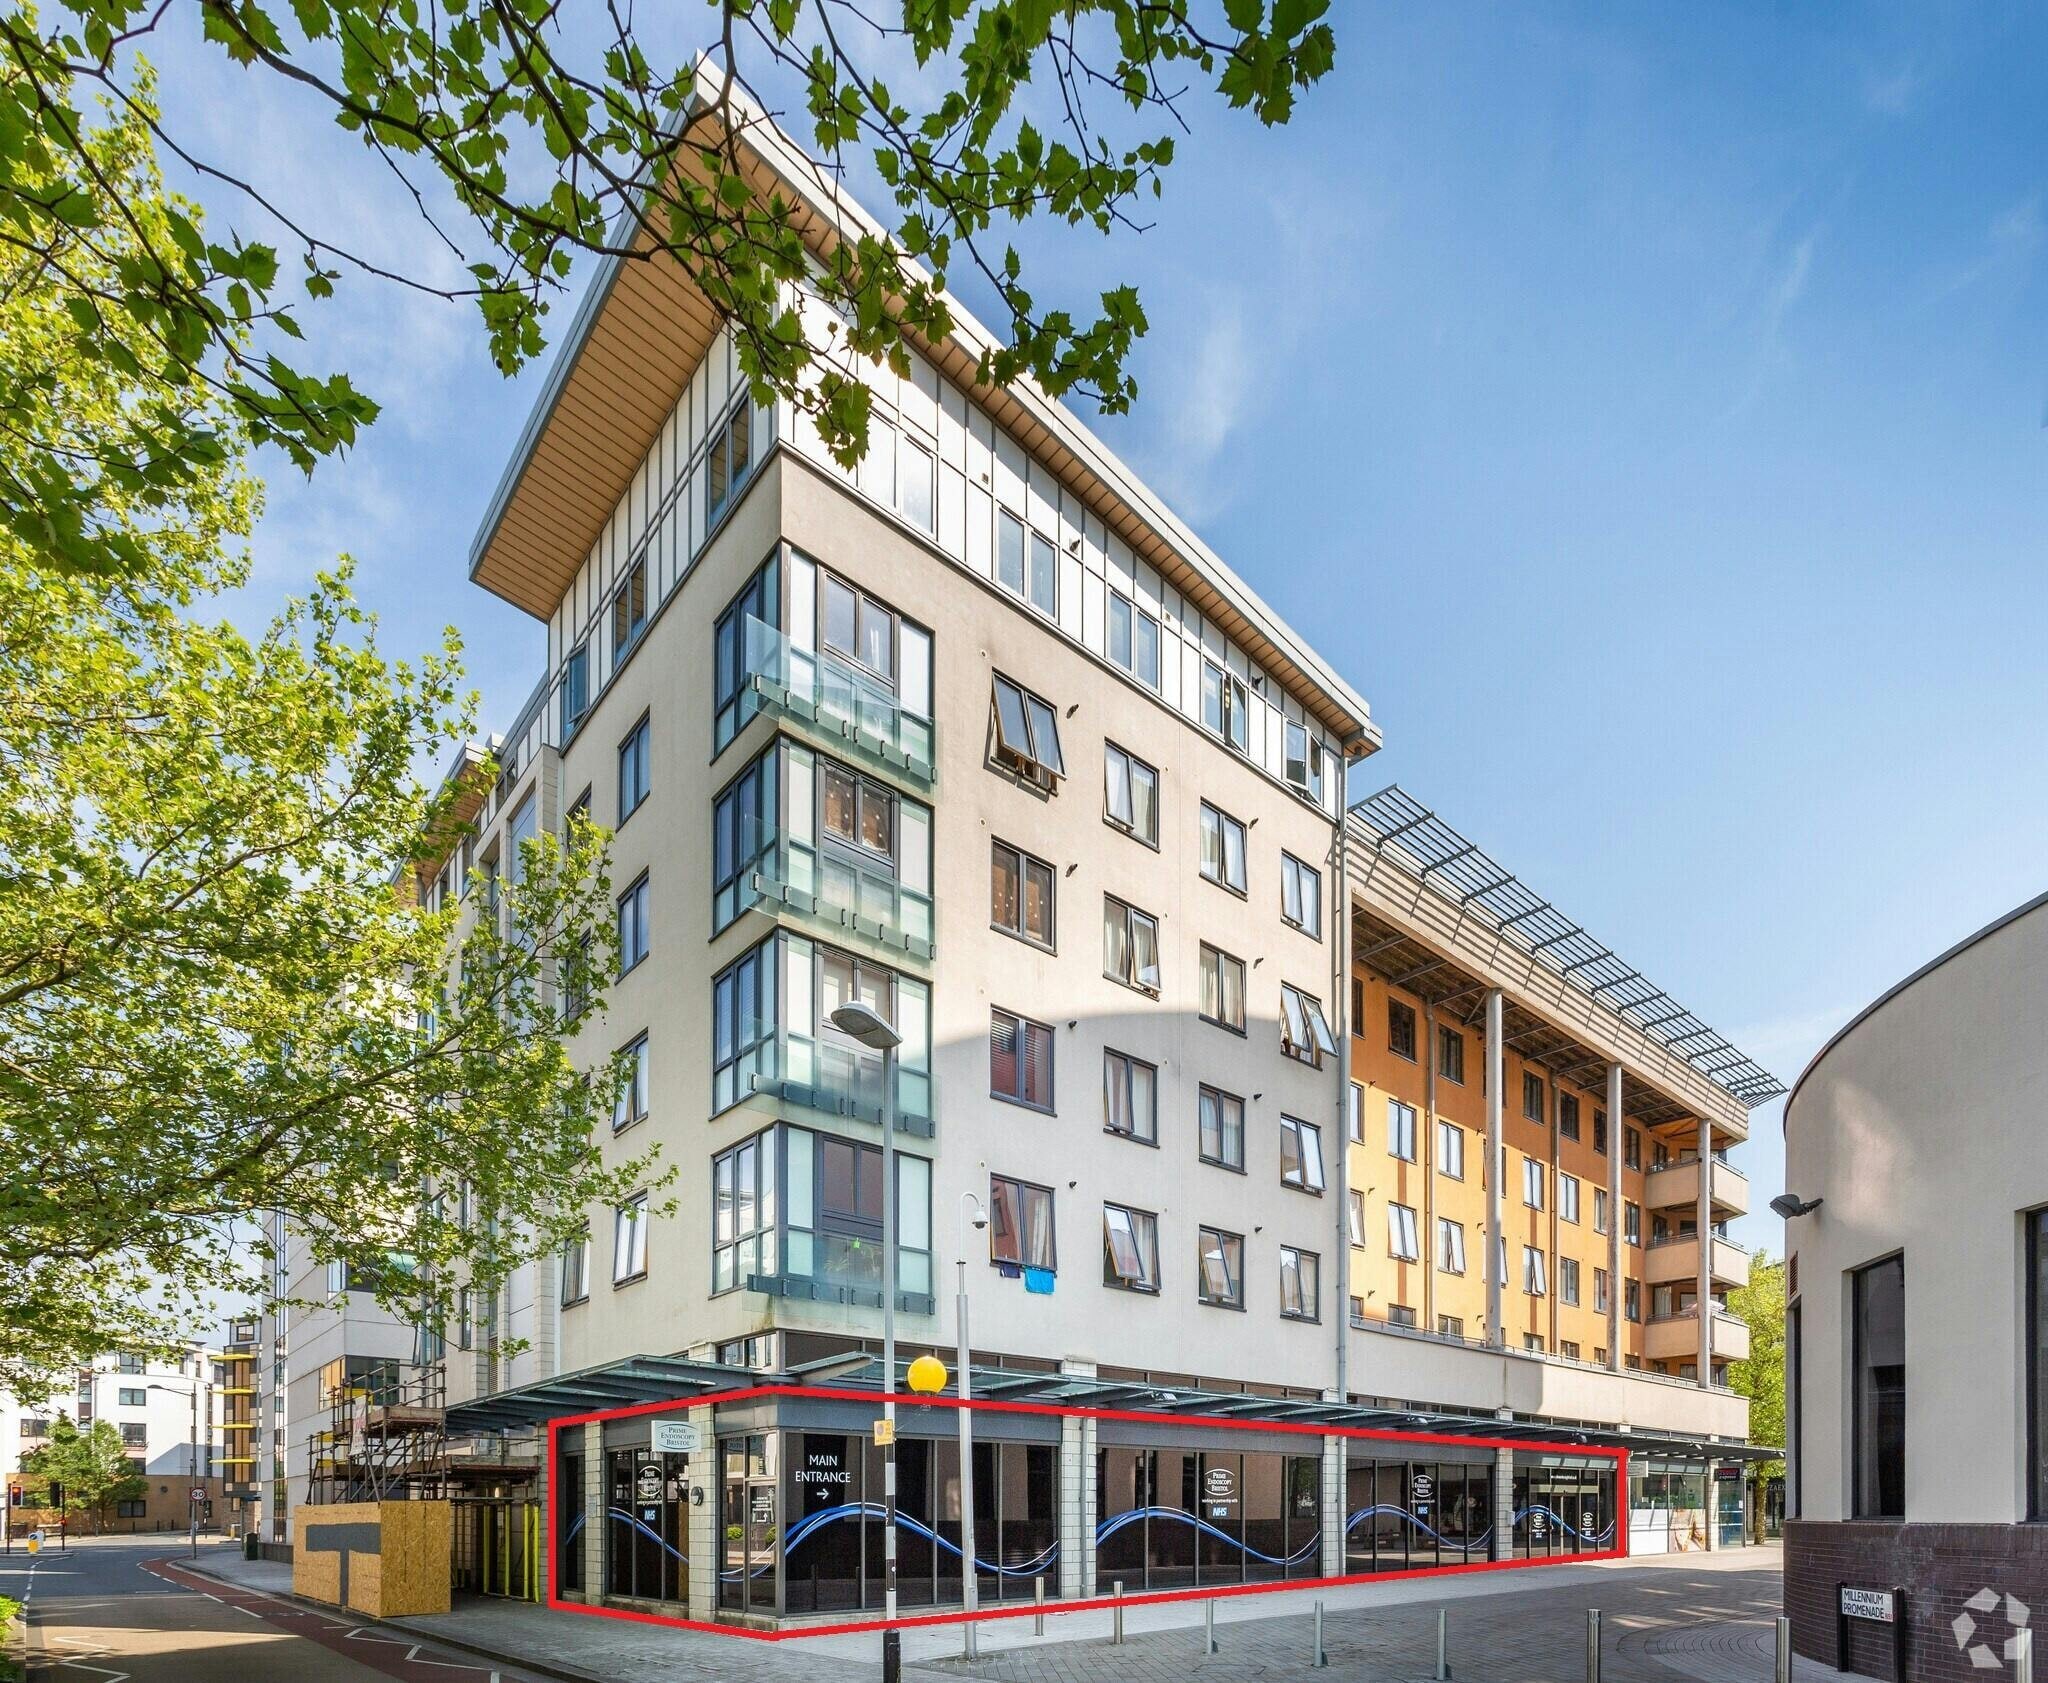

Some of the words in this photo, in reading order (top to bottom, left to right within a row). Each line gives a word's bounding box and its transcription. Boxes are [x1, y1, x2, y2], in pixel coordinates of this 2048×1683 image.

[809, 1454, 838, 1466] MAIN
[795, 1470, 851, 1483] ENTRANCE
[644, 1509, 656, 1521] NHS
[1212, 1507, 1228, 1517] NHS
[1417, 1506, 1429, 1515] NHS
[1844, 1590, 1884, 1606] MILLENNIUM
[1843, 1602, 1885, 1619] PROMENADE
